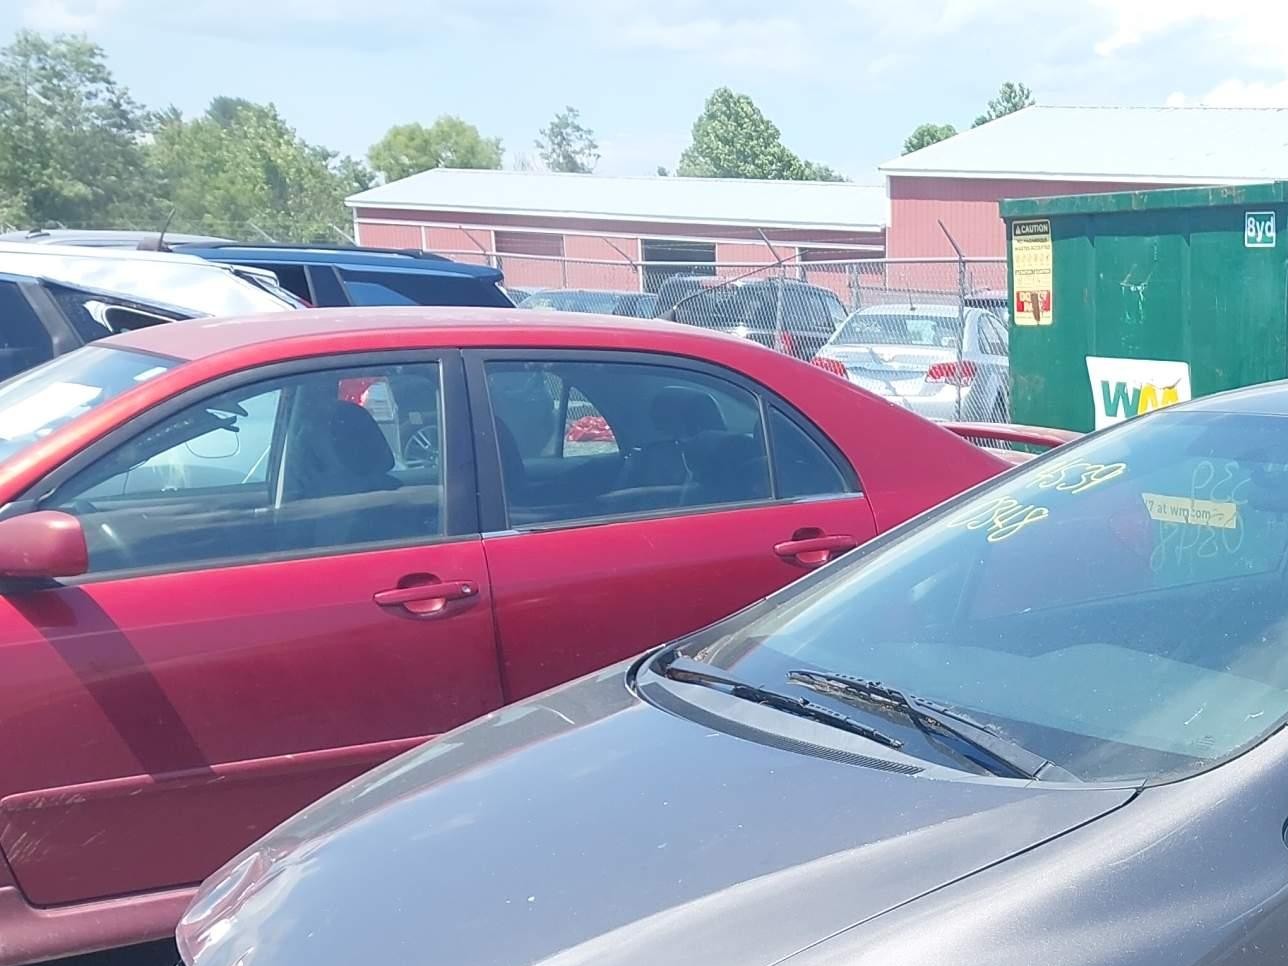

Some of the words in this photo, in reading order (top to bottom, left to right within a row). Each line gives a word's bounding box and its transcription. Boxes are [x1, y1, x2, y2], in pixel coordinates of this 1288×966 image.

[1020, 223, 1049, 235] CAUTION
[1247, 215, 1274, 242] 8yd
[1157, 503, 1168, 514] at
